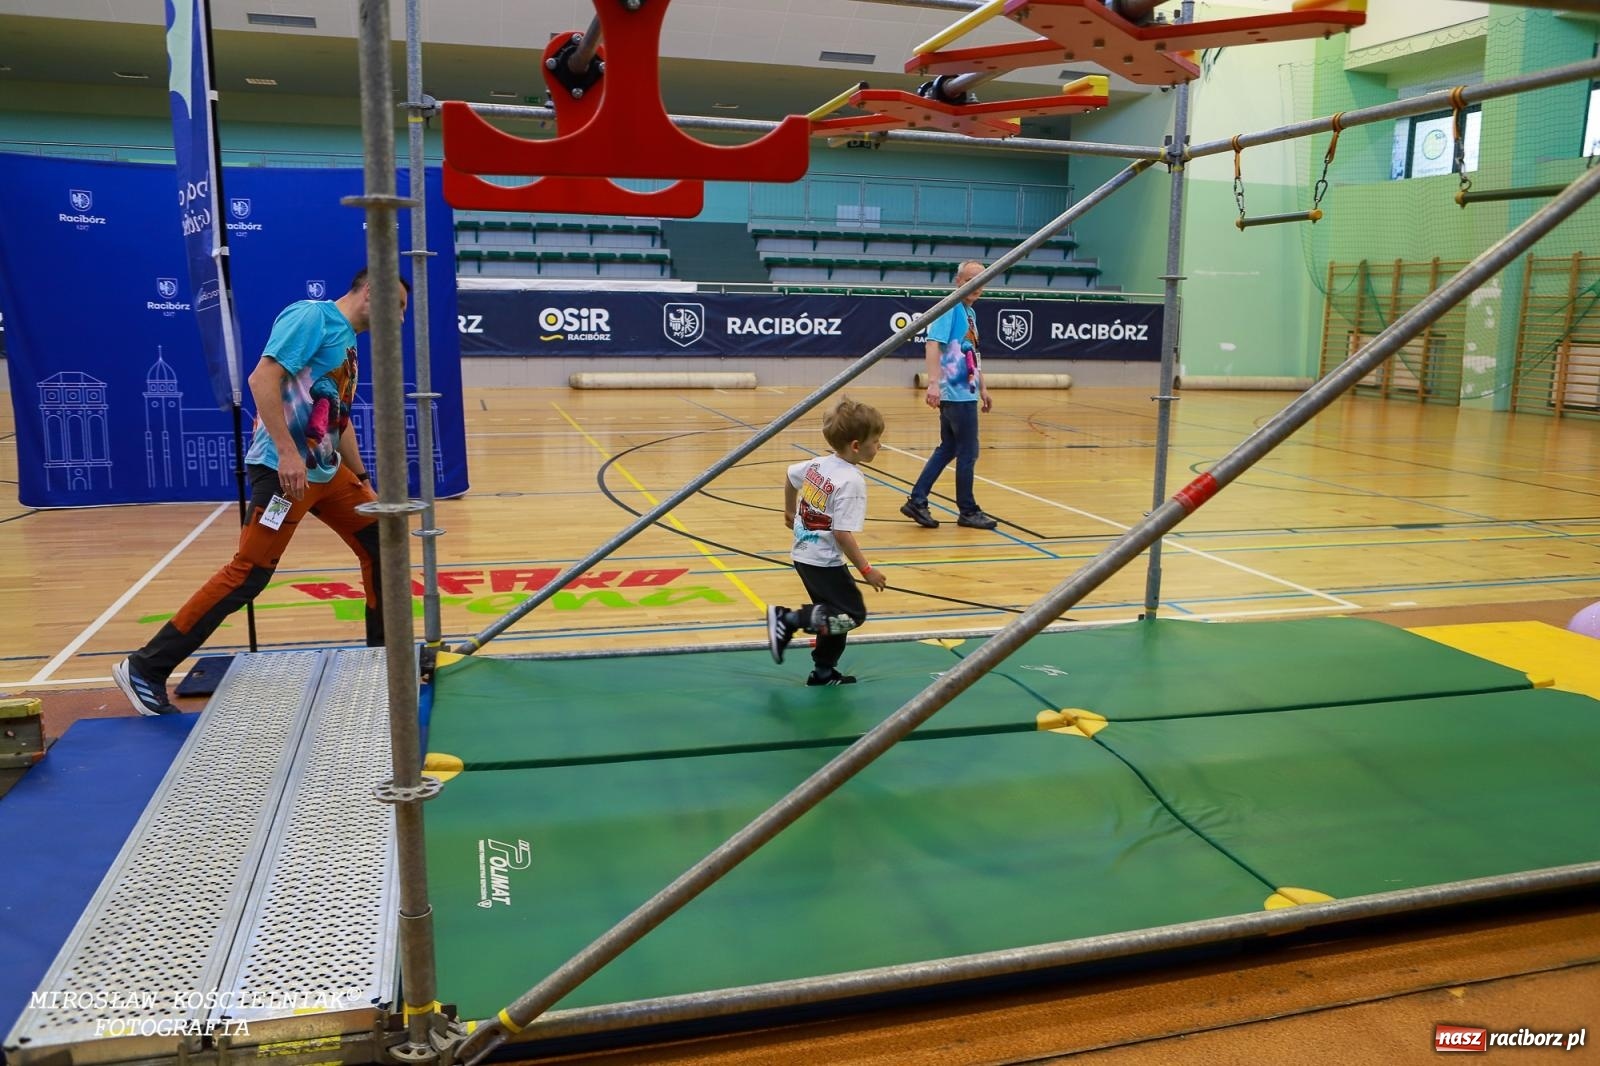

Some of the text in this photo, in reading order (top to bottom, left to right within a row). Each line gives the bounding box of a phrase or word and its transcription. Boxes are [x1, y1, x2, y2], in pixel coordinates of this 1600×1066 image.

[59, 213, 106, 224] Racibórz
[226, 221, 263, 231] acibórz
[147, 301, 190, 311] Racibórz
[727, 312, 842, 335] RACIBÓRZ
[1051, 319, 1149, 340] RACIBÓRZ
[567, 333, 612, 341] RACIBÓRZ
